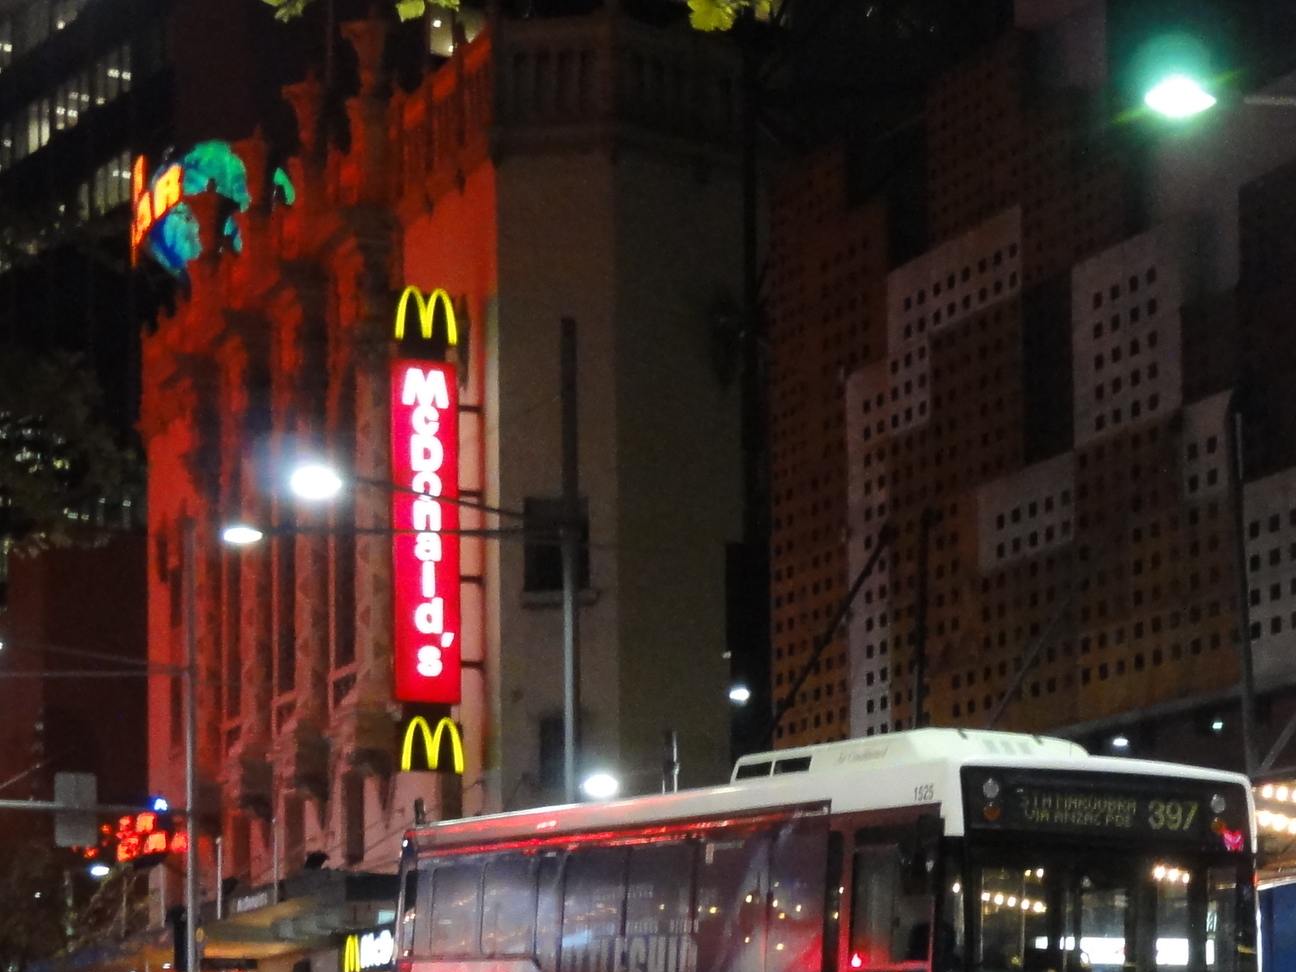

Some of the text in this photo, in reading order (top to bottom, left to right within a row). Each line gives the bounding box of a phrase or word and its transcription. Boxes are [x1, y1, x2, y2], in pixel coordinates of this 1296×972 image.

[402, 368, 455, 677] McDonald's
[914, 783, 934, 802] 1525
[1148, 800, 1199, 831] 397
